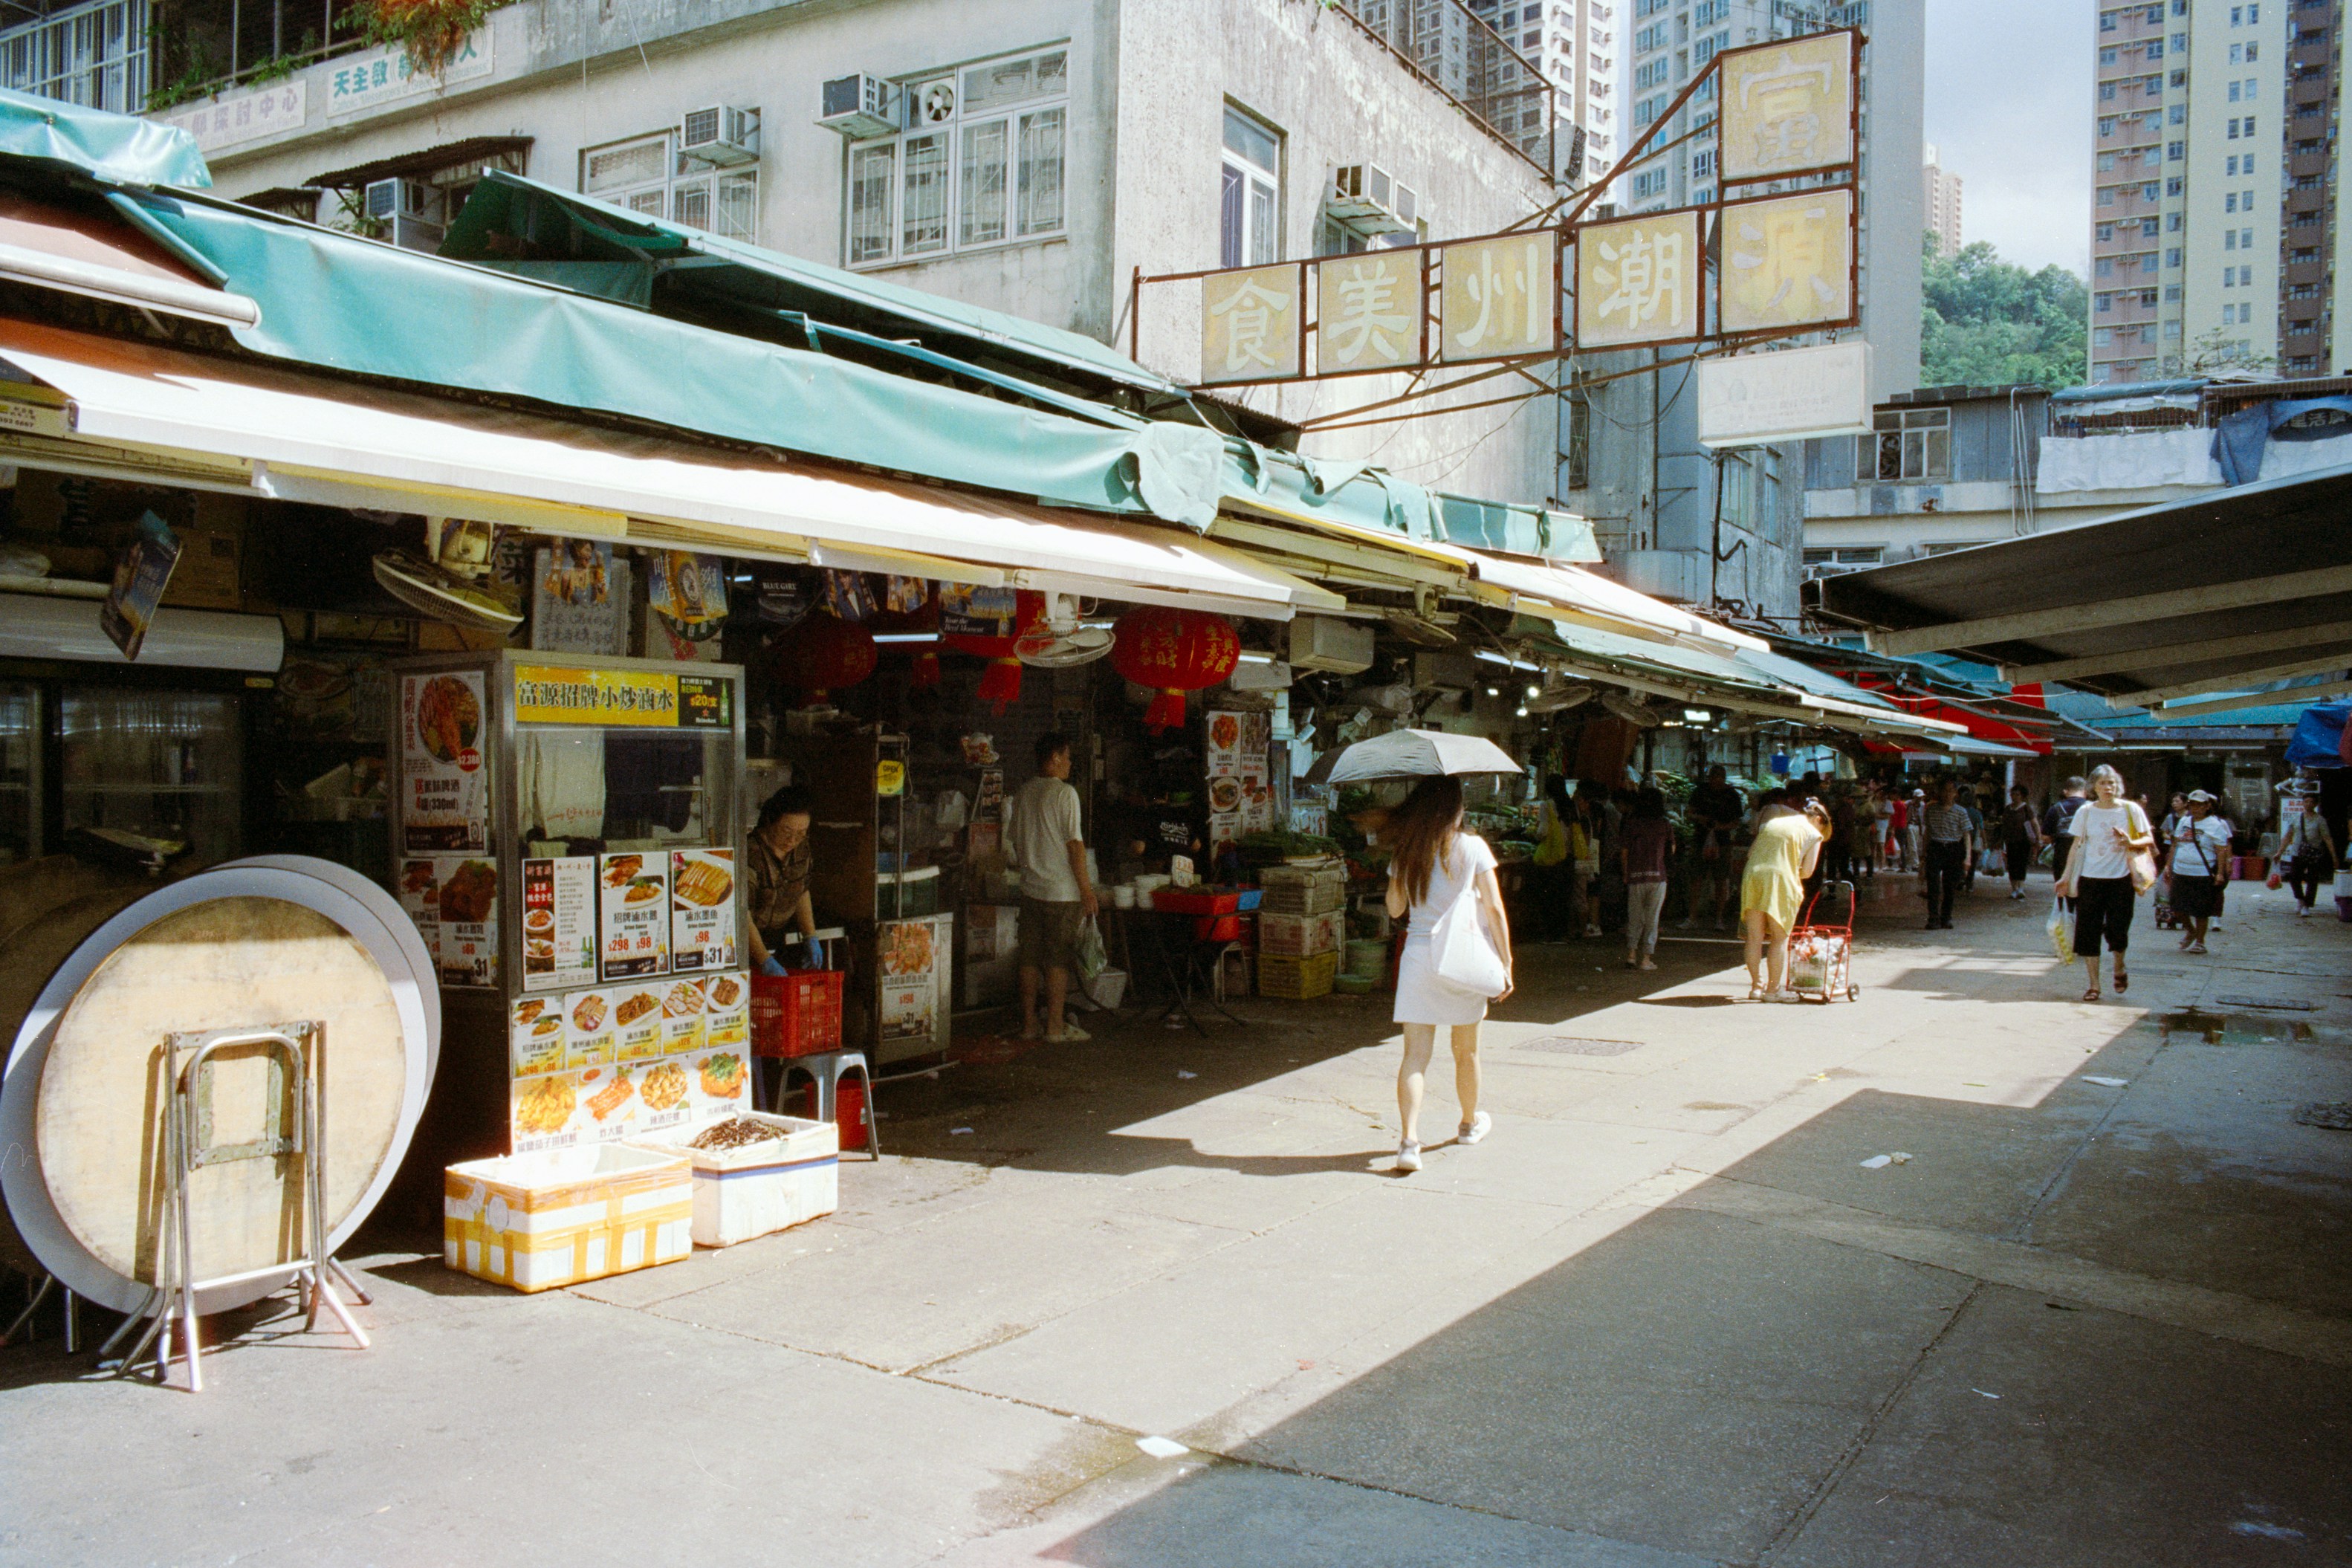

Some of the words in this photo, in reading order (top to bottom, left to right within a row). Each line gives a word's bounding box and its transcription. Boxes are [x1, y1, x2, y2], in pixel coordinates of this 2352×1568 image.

[762, 582, 779, 591] BLUE
[780, 582, 797, 591] GIRL
[518, 680, 675, 713] 富源招牌小炒滷水
[882, 764, 898, 773] OPEN
[685, 909, 718, 921] 滷水墨魚
[636, 936, 652, 950] $98
[695, 930, 710, 943] $98
[608, 938, 629, 952] $298
[704, 947, 722, 964] $31
